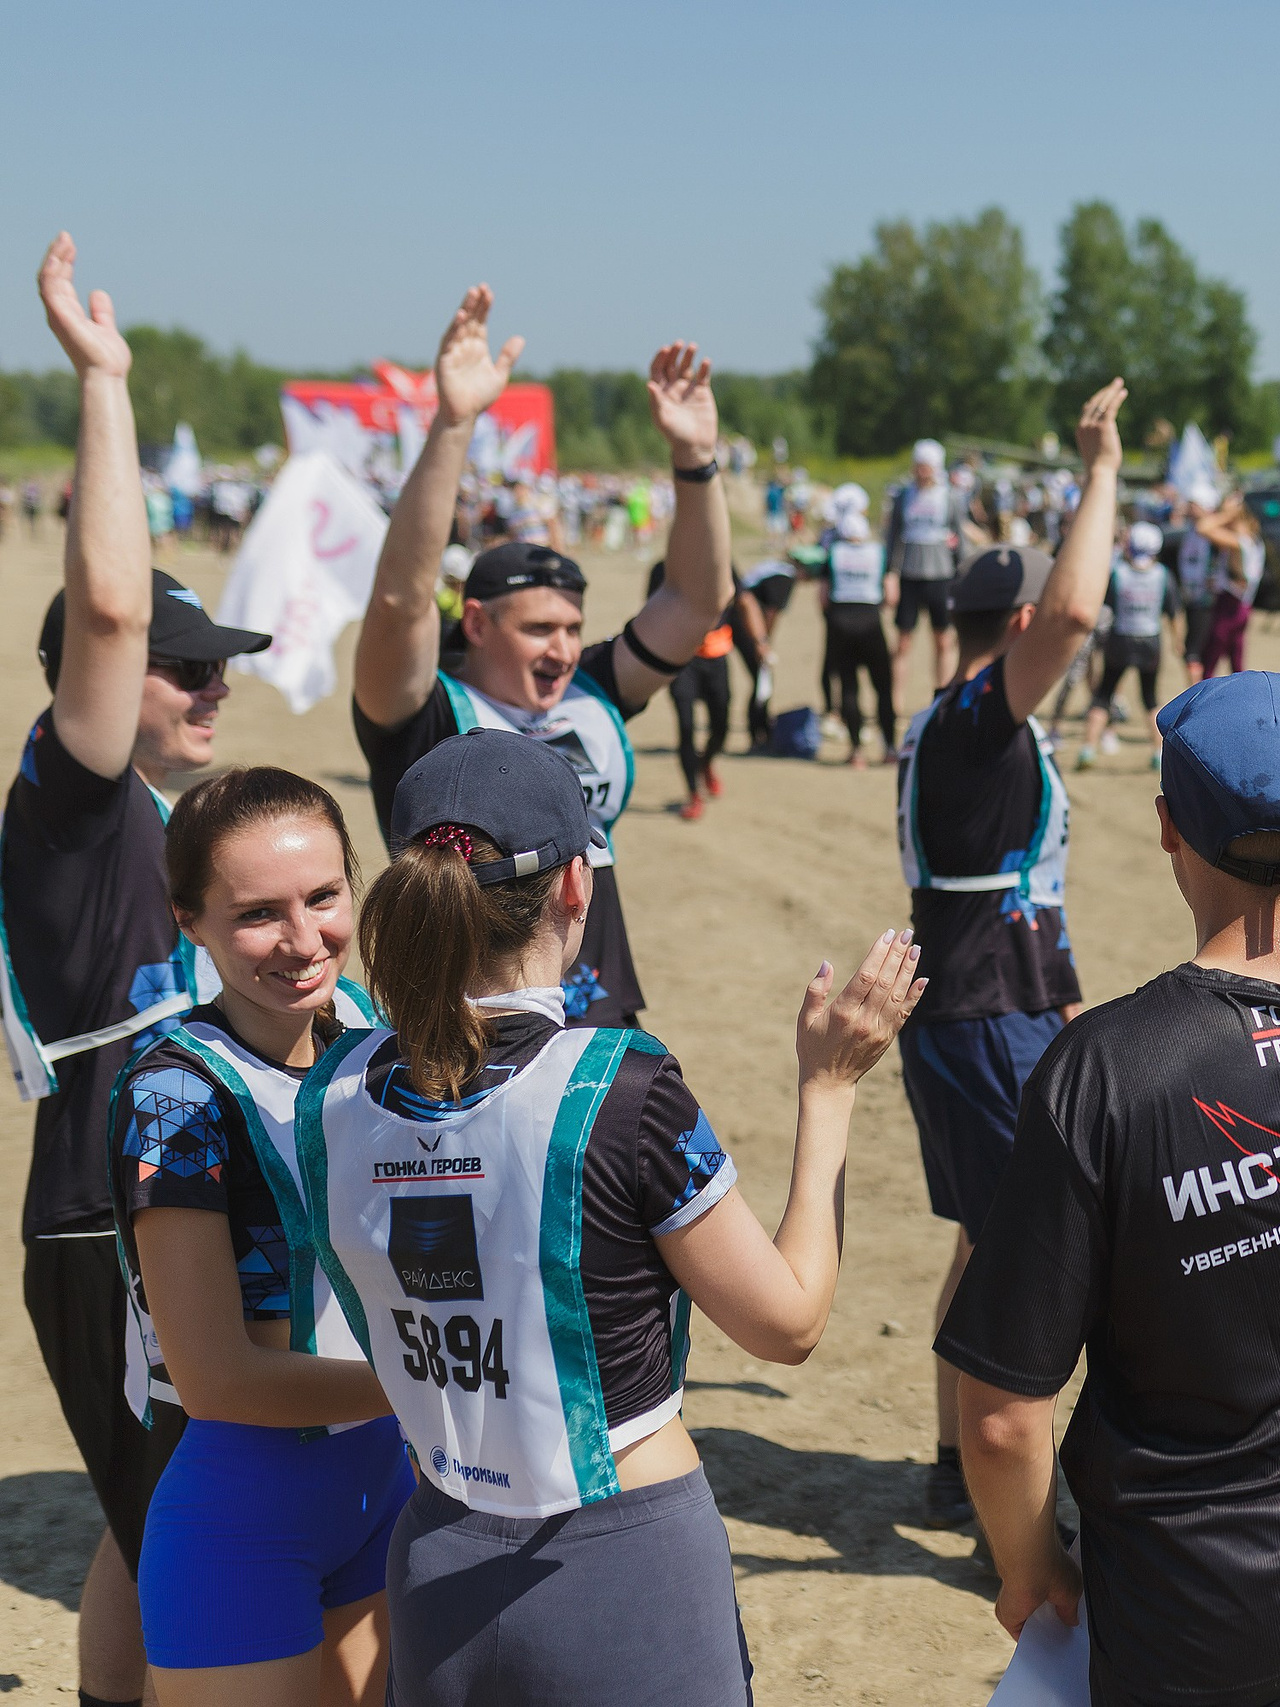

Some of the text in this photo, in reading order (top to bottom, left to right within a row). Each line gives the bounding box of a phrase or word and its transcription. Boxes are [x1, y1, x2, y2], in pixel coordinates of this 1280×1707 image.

[373, 1157, 483, 1178] ГОНКА ГЕРОЕВ
[401, 1267, 476, 1290] РАЙДЕКС
[390, 1307, 511, 1400] 5894
